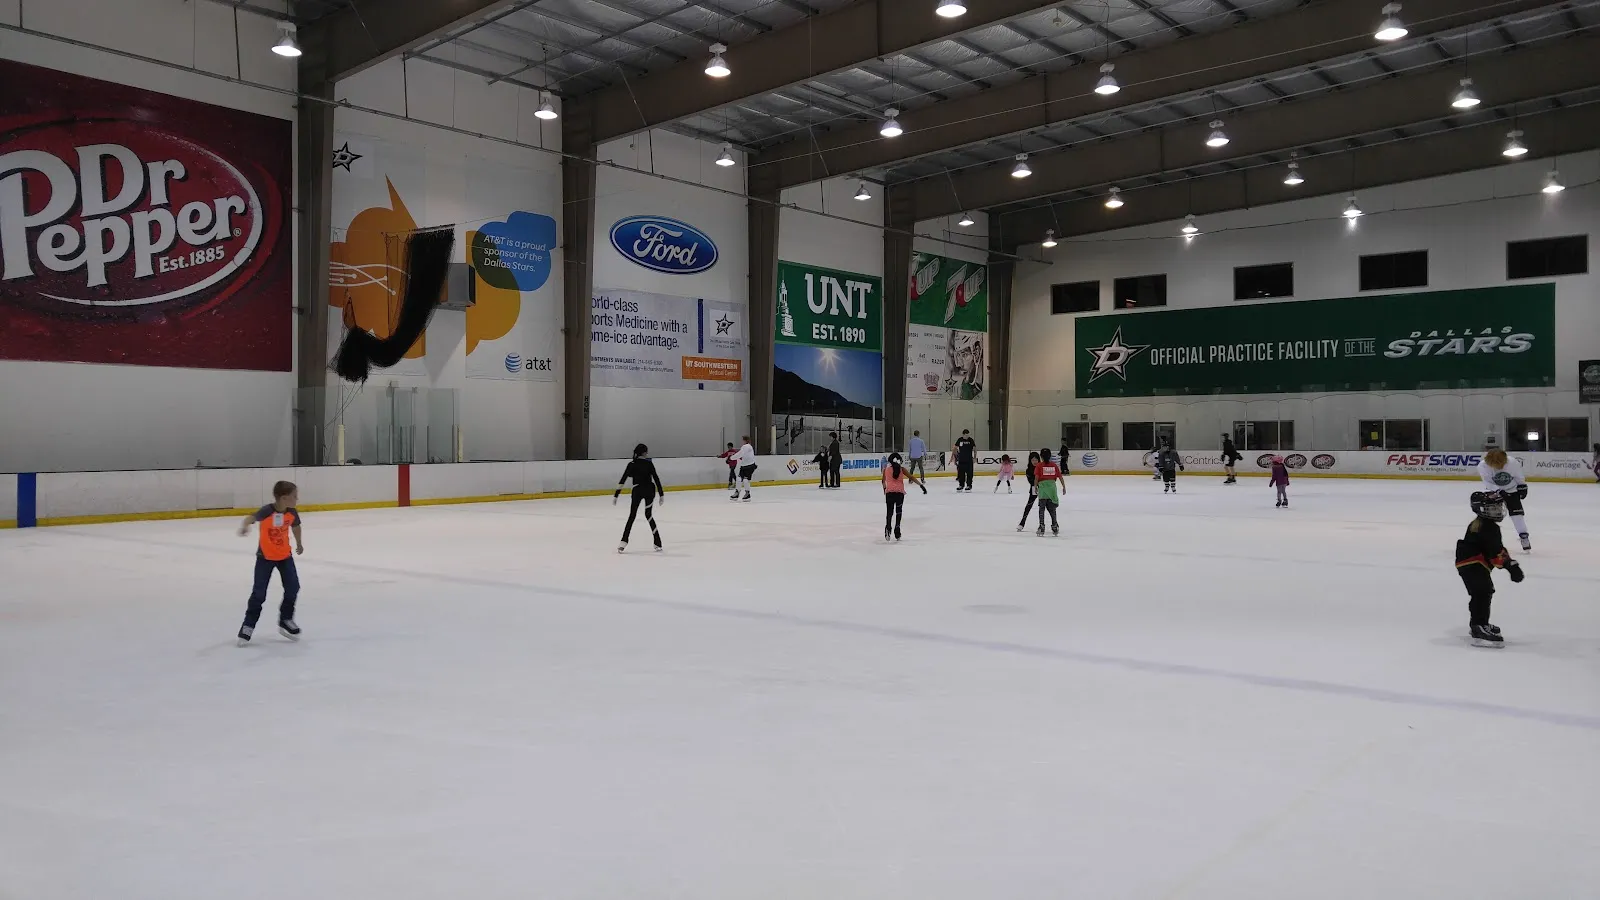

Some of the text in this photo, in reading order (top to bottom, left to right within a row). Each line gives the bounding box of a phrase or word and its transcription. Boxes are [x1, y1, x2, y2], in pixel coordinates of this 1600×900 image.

[74, 143, 186, 218] Dr
[0, 149, 246, 287] Pepper
[484, 235, 506, 245] AT&T
[507, 238, 514, 246] is
[521, 242, 547, 251] proud
[633, 223, 698, 266] Ford
[484, 247, 543, 262] sponsor of the
[484, 258, 536, 272] Dallas Stars.
[591, 296, 639, 313] orld-class
[804, 273, 872, 319] UNT
[591, 313, 688, 333] orts Medicine with a
[812, 323, 865, 343] EST. 1890
[1410, 326, 1513, 338] DALLAS
[591, 330, 679, 351] ome-ice advantage.
[1383, 333, 1536, 359] STARS
[1150, 339, 1375, 366] OFFICIAL PRACTICE FACILITY OF THE
[525, 356, 551, 371] at&t
[977, 457, 1018, 465] LEXS
[1387, 454, 1481, 466] FASTSIGNS
